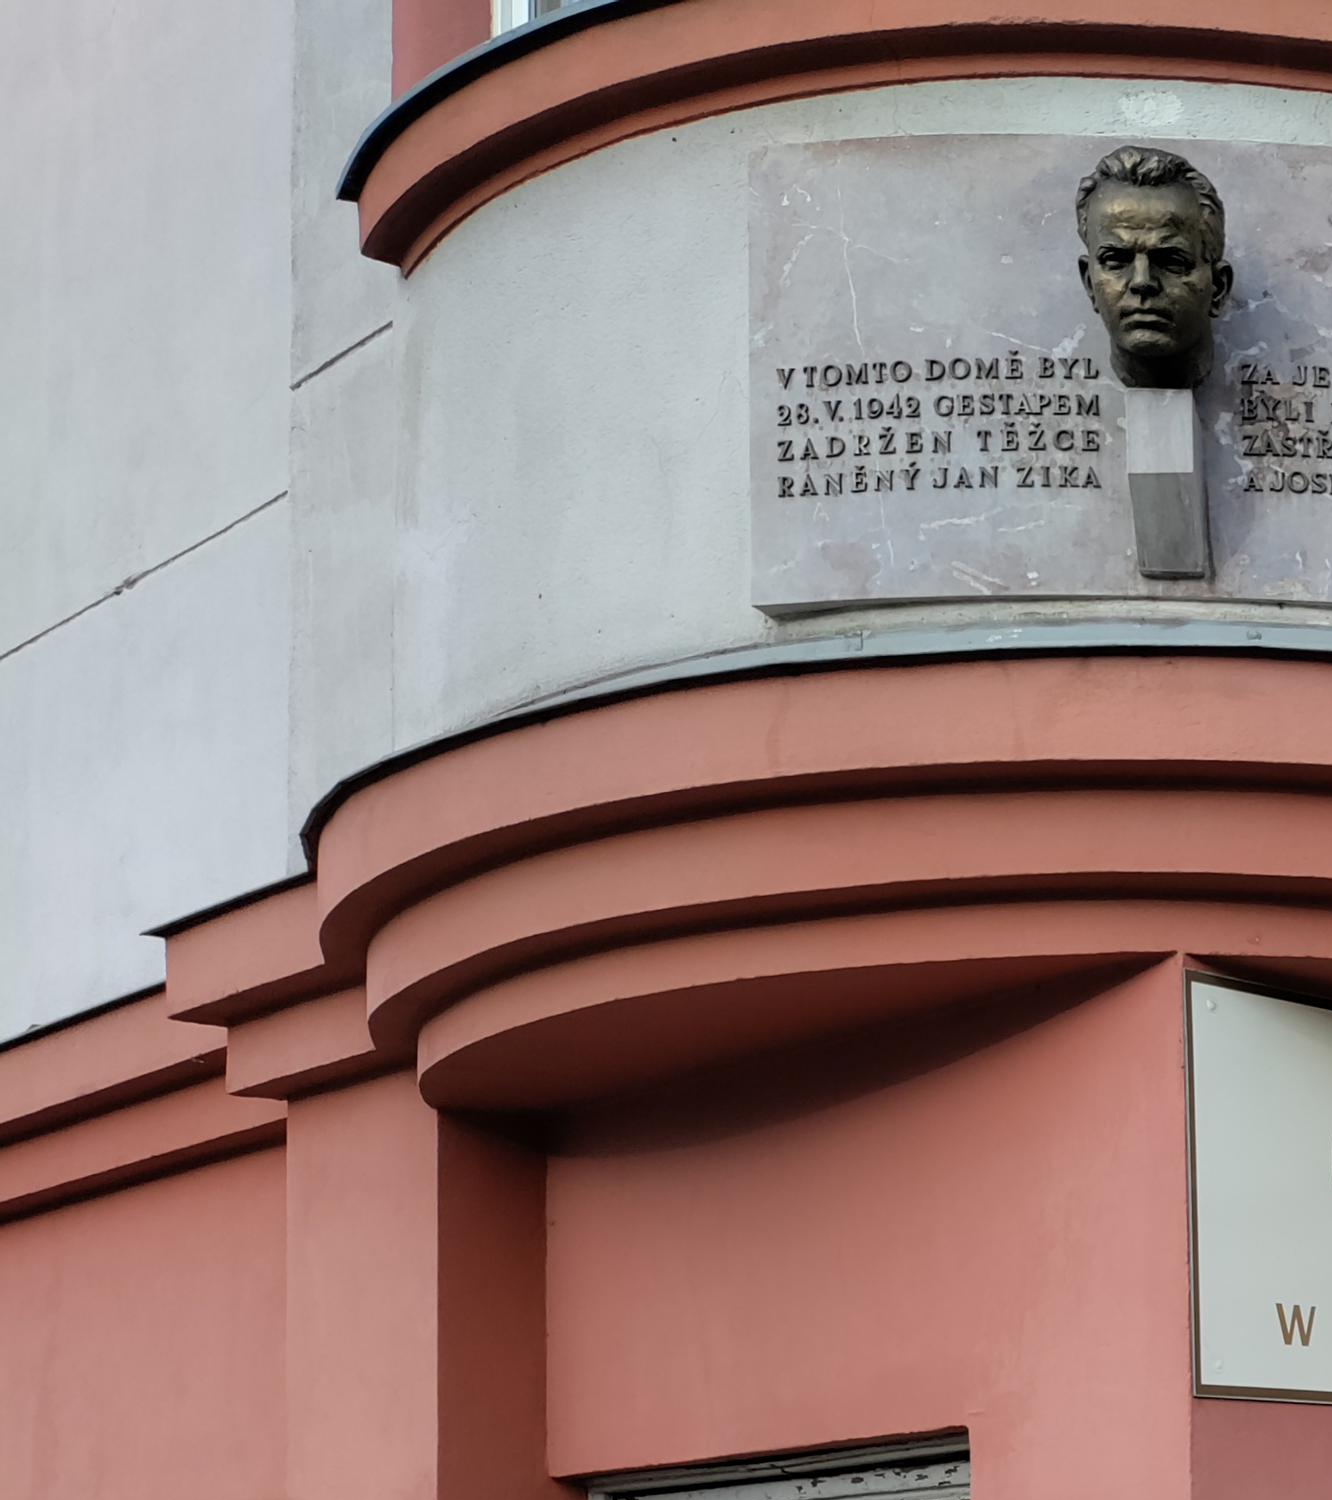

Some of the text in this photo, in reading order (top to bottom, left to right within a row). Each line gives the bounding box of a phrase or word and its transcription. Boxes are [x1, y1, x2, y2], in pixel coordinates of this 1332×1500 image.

[777, 350, 1100, 389] V TOMTO DOMĚ BYL
[1240, 364, 1280, 386] ZA
[934, 393, 1100, 417] GESTAPEM
[1241, 397, 1314, 424] BYLI
[777, 421, 1101, 462] ZADRŽEN TĚŽCE
[777, 461, 1102, 498] RANĚNÝ JAN ZIKA
[1244, 474, 1263, 493] A
